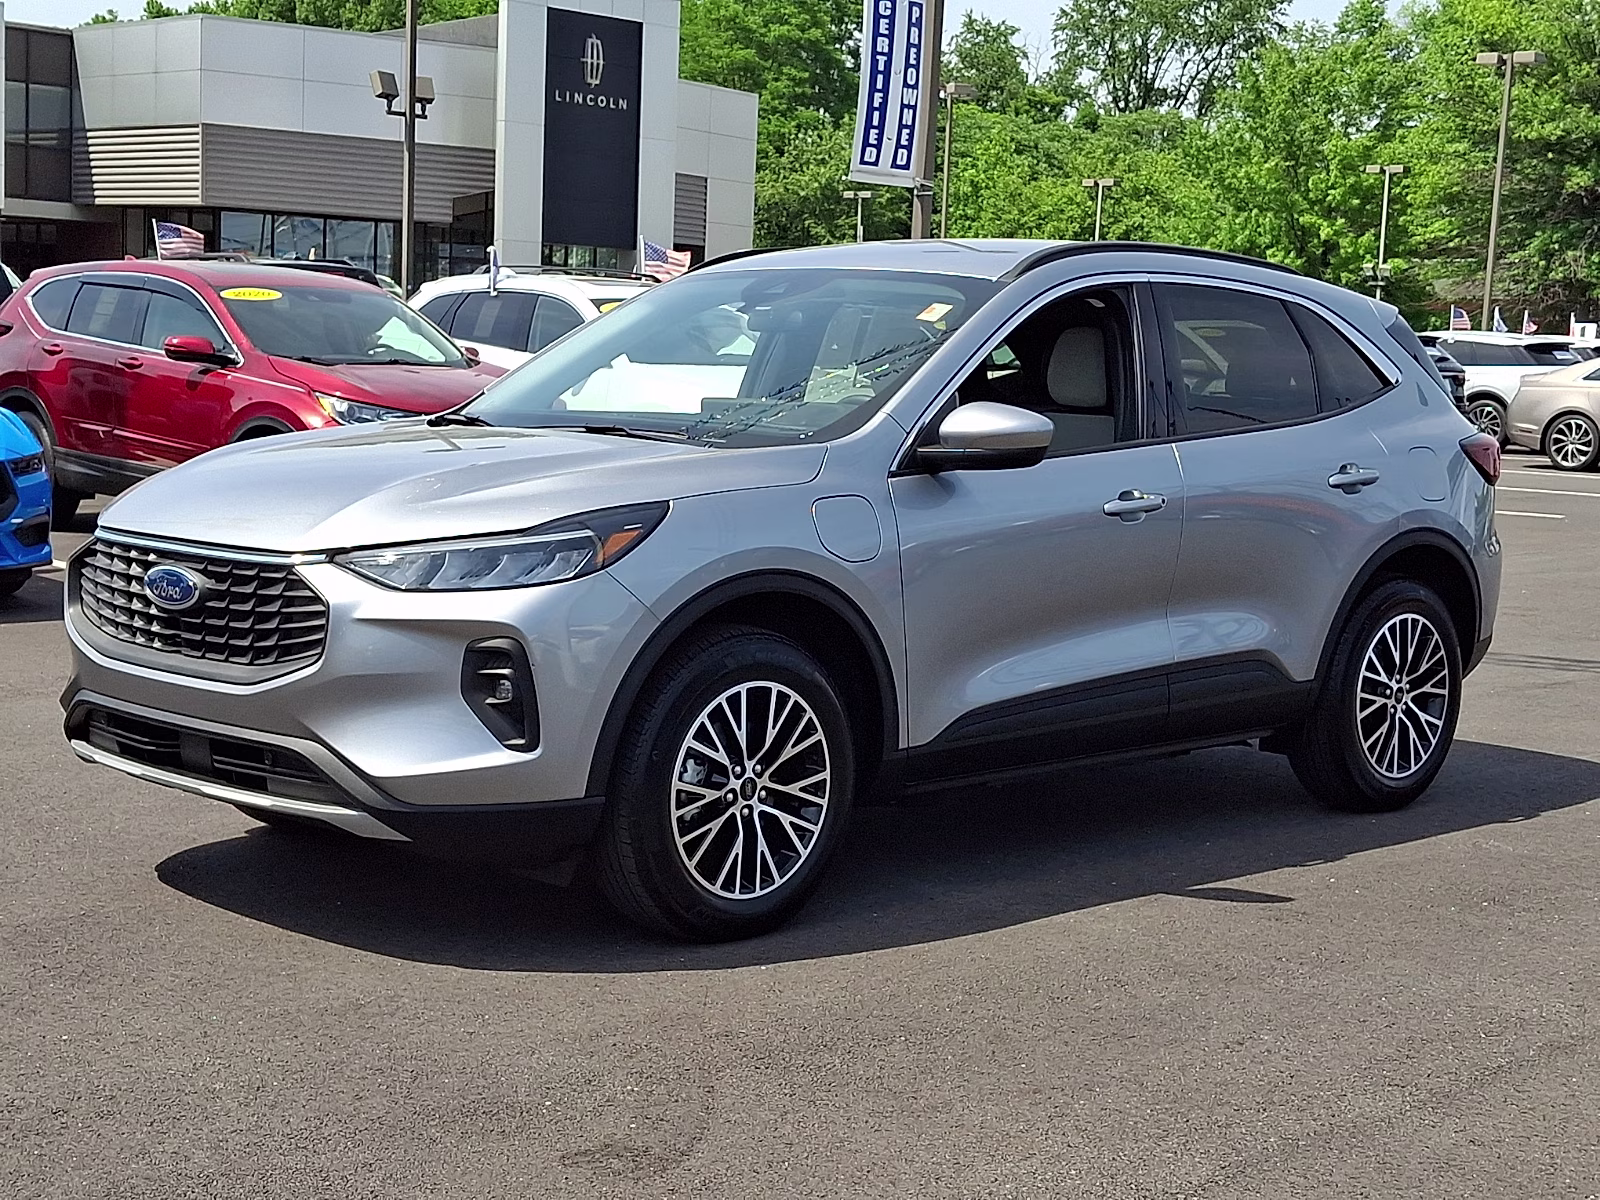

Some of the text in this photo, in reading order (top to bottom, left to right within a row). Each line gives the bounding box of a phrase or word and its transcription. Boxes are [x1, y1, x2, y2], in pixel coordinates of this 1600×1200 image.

[864, 0, 892, 163] CERTIFIED
[896, 5, 920, 165] PREOWNED
[555, 89, 628, 110] LINCOLN
[232, 290, 272, 298] 2020
[152, 572, 184, 600] Ford
